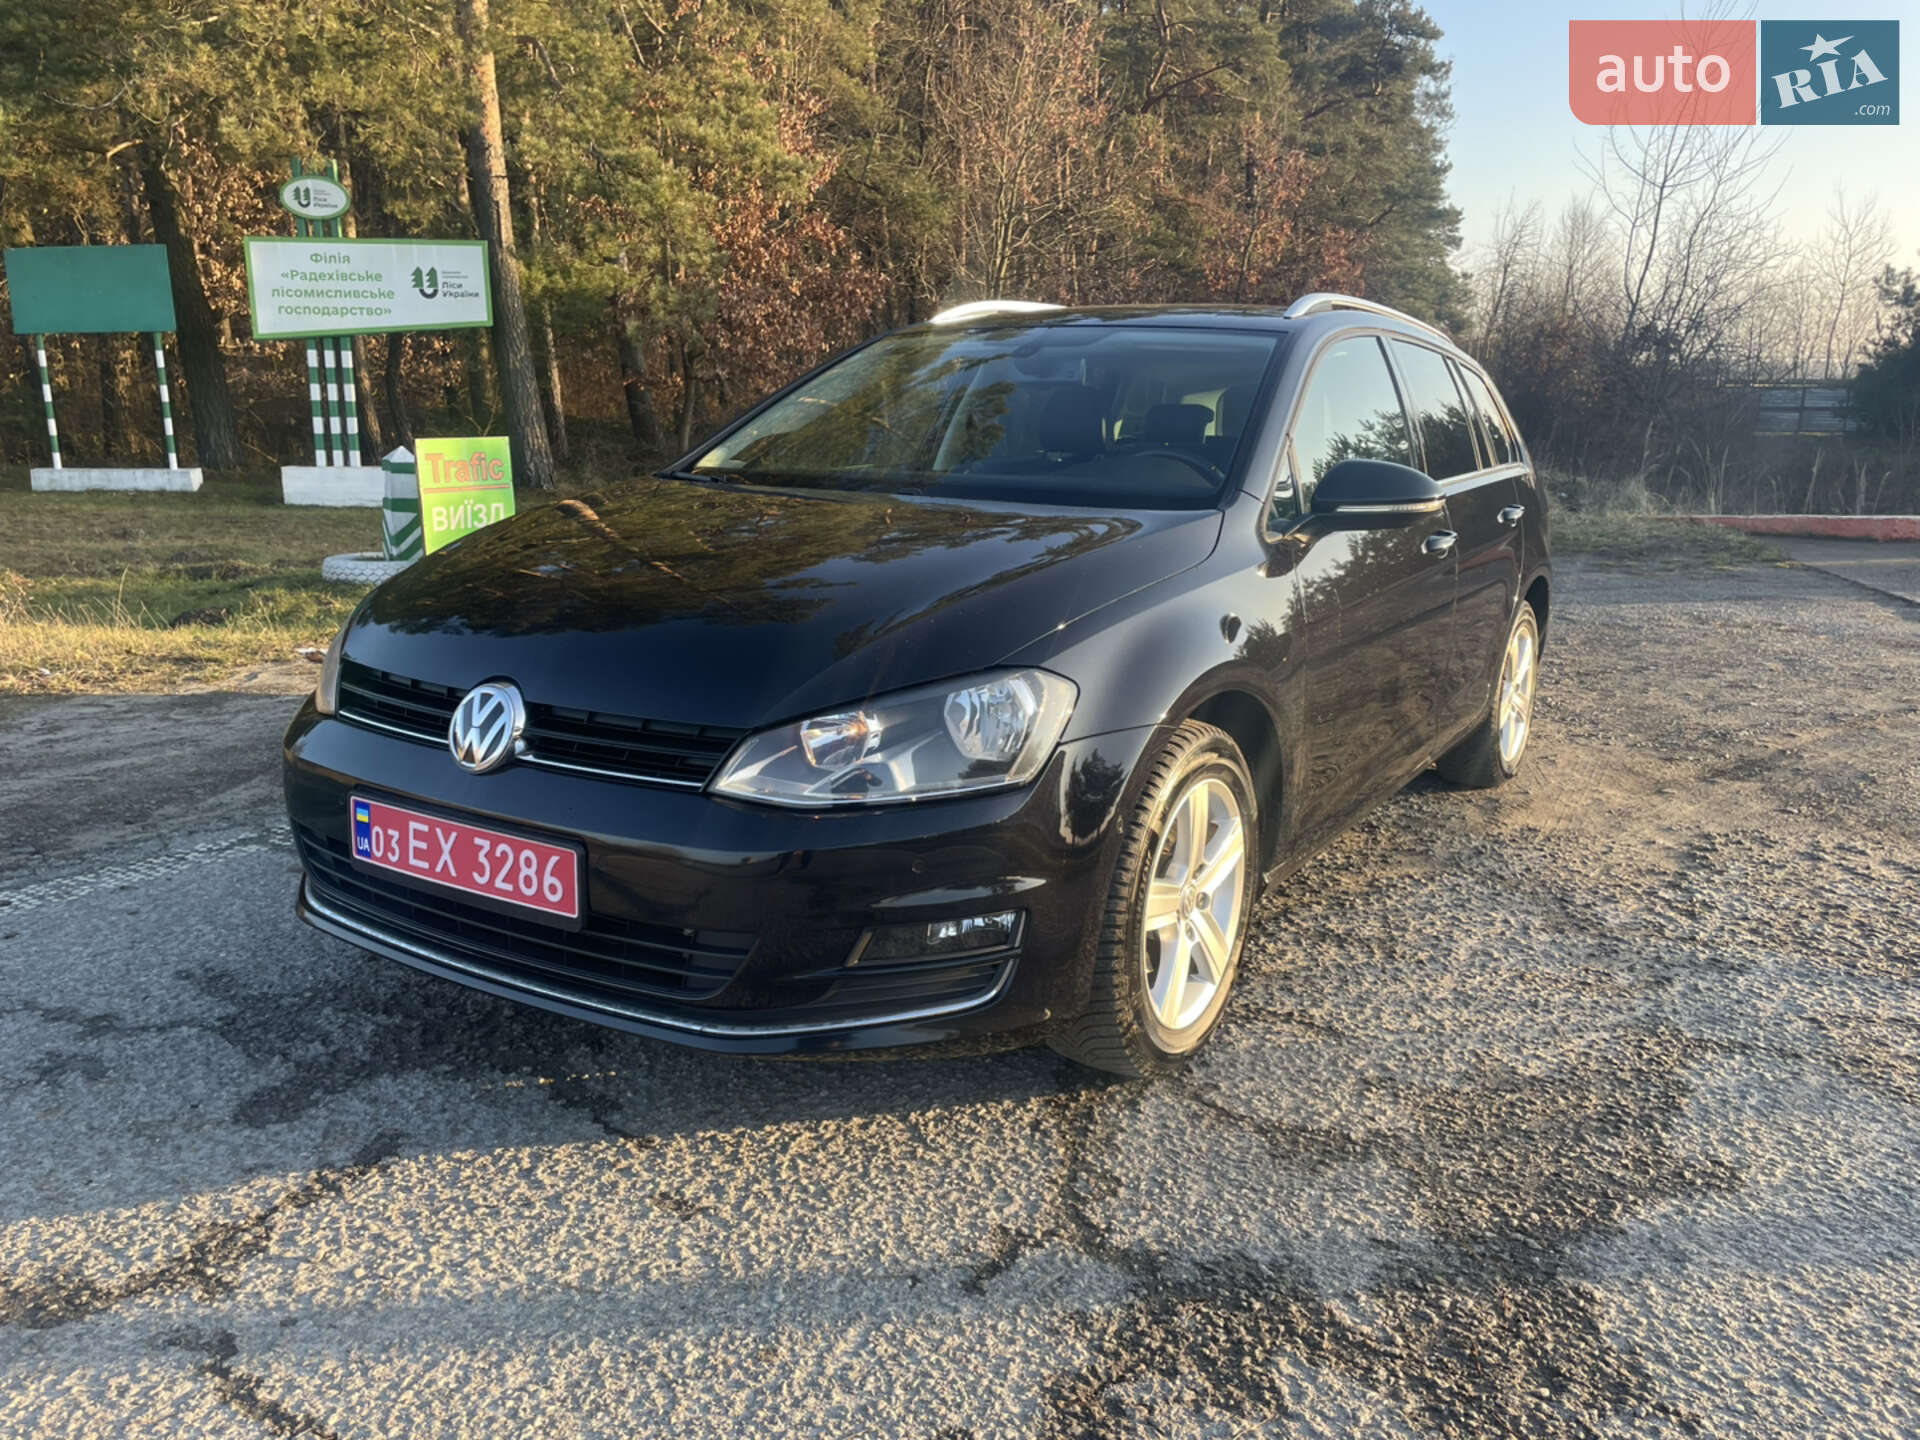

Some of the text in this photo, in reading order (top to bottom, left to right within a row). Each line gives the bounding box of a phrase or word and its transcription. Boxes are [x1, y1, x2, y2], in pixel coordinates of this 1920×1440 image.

[309, 252, 351, 264] Філія
[271, 286, 396, 299] лісомисливське
[278, 304, 392, 318] господарство»
[424, 451, 505, 484] Trafic
[357, 835, 370, 852] UA
[472, 836, 564, 903] 3286
